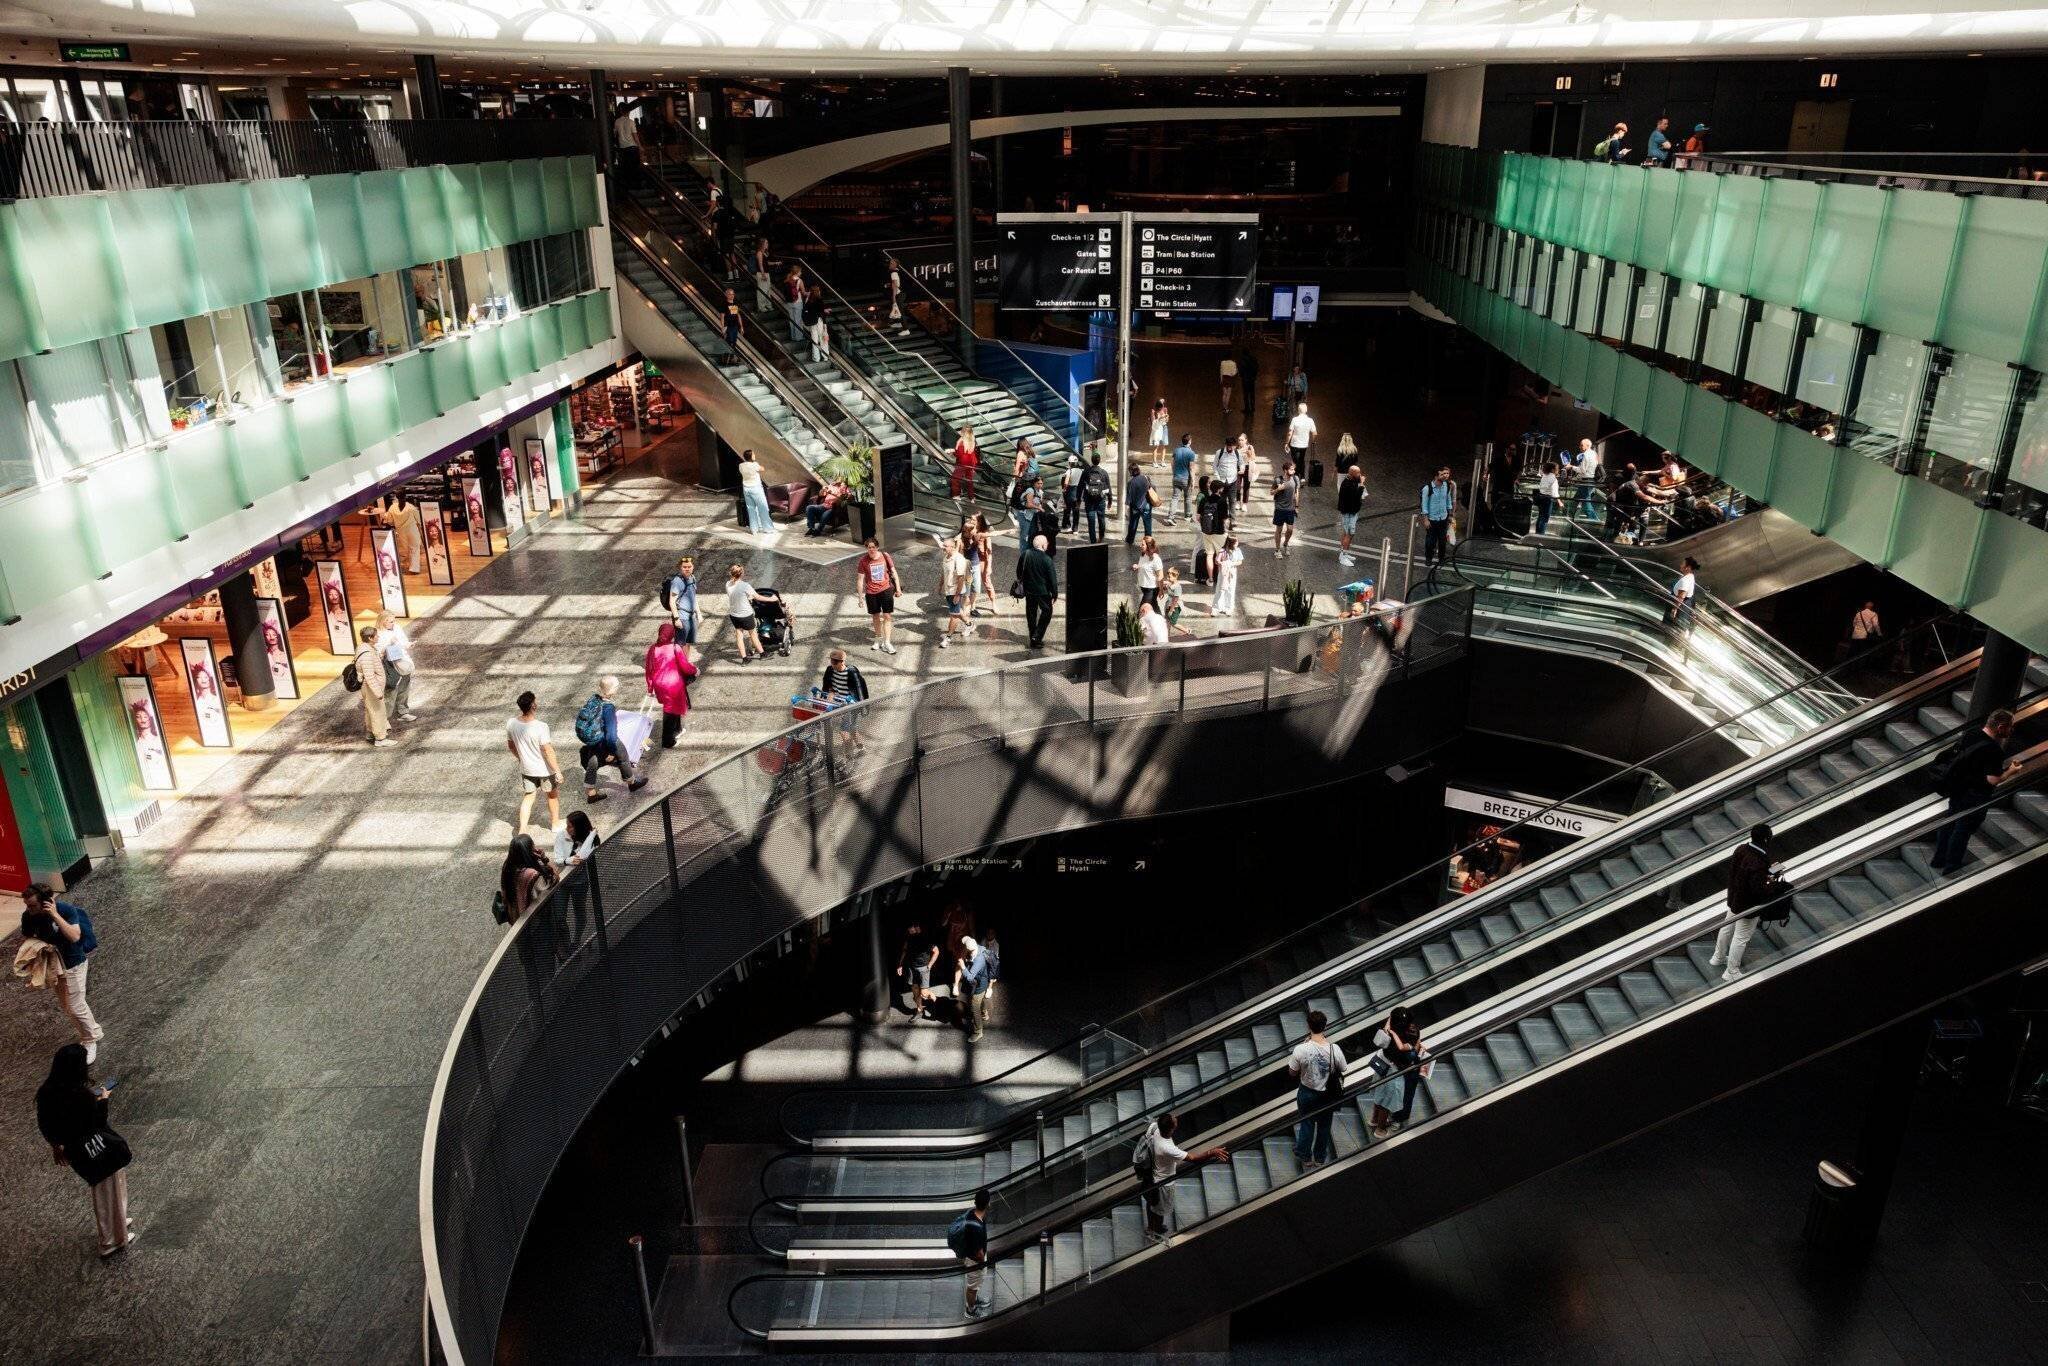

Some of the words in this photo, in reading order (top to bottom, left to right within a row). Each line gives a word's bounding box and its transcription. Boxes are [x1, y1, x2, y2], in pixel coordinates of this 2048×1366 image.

[1076, 250, 1097, 258] Gates
[0, 666, 36, 698] RIST
[981, 857, 1008, 865] Station
[1069, 865, 1089, 873] Hyatt
[84, 1132, 107, 1159] GAP
